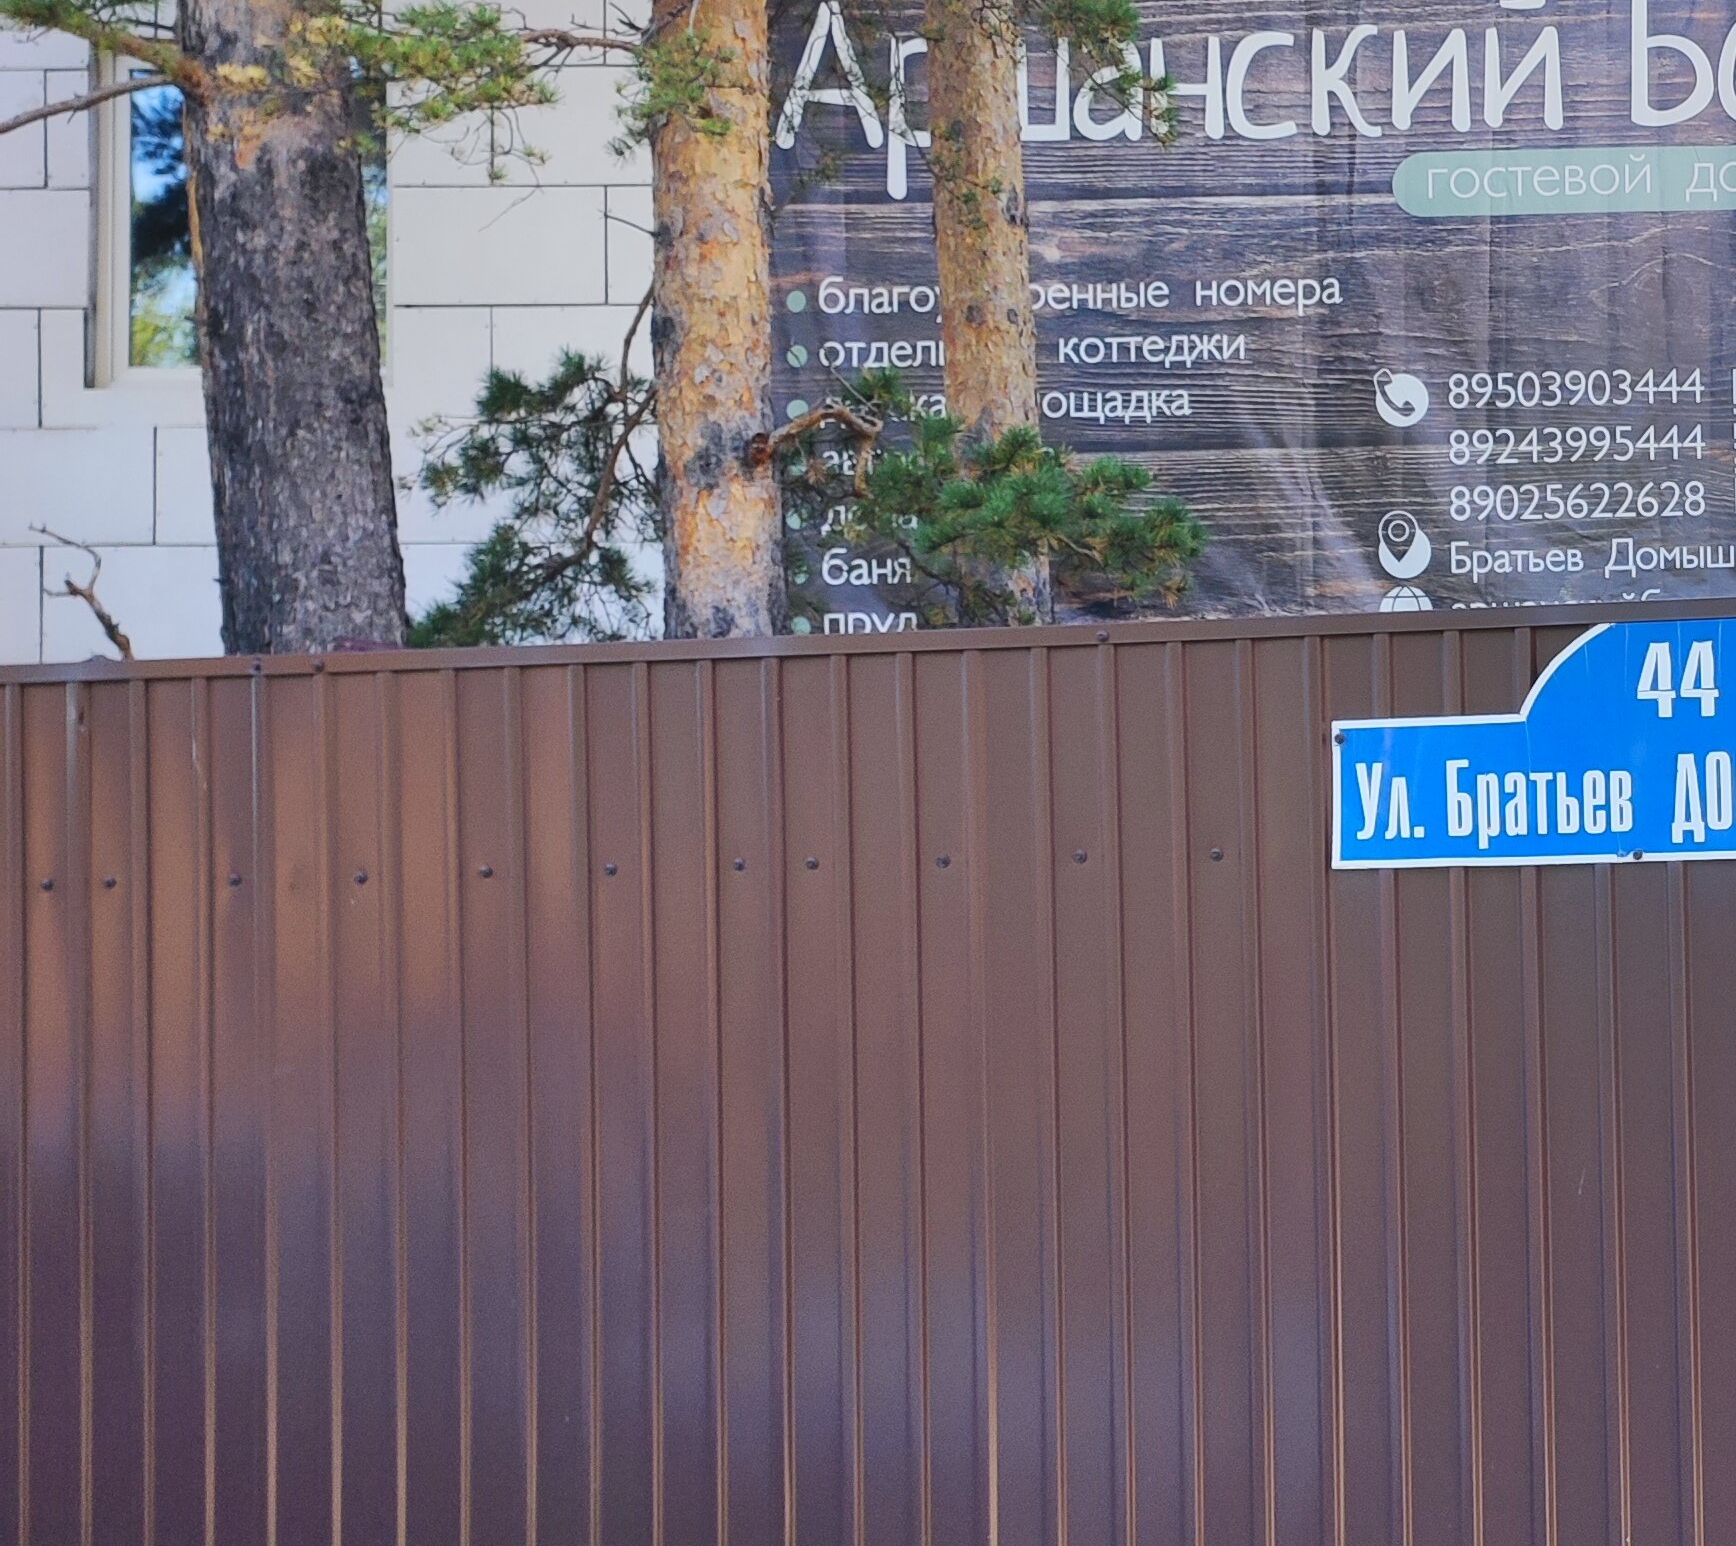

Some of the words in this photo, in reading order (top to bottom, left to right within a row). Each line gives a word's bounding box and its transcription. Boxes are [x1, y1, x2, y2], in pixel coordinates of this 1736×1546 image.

[1427, 154, 1652, 200] гостевой
[1195, 276, 1344, 317] номера
[1058, 333, 1246, 369] коттеджи
[1448, 368, 1705, 410] 89503903444
[1448, 424, 1706, 466] 89243995444
[1449, 480, 1706, 522] 89025622628
[821, 547, 913, 587] баня
[1450, 540, 1584, 584] Братьев
[1636, 639, 1720, 719] 44
[1355, 762, 1426, 841] Ул.
[1446, 758, 1634, 850] Братьев
